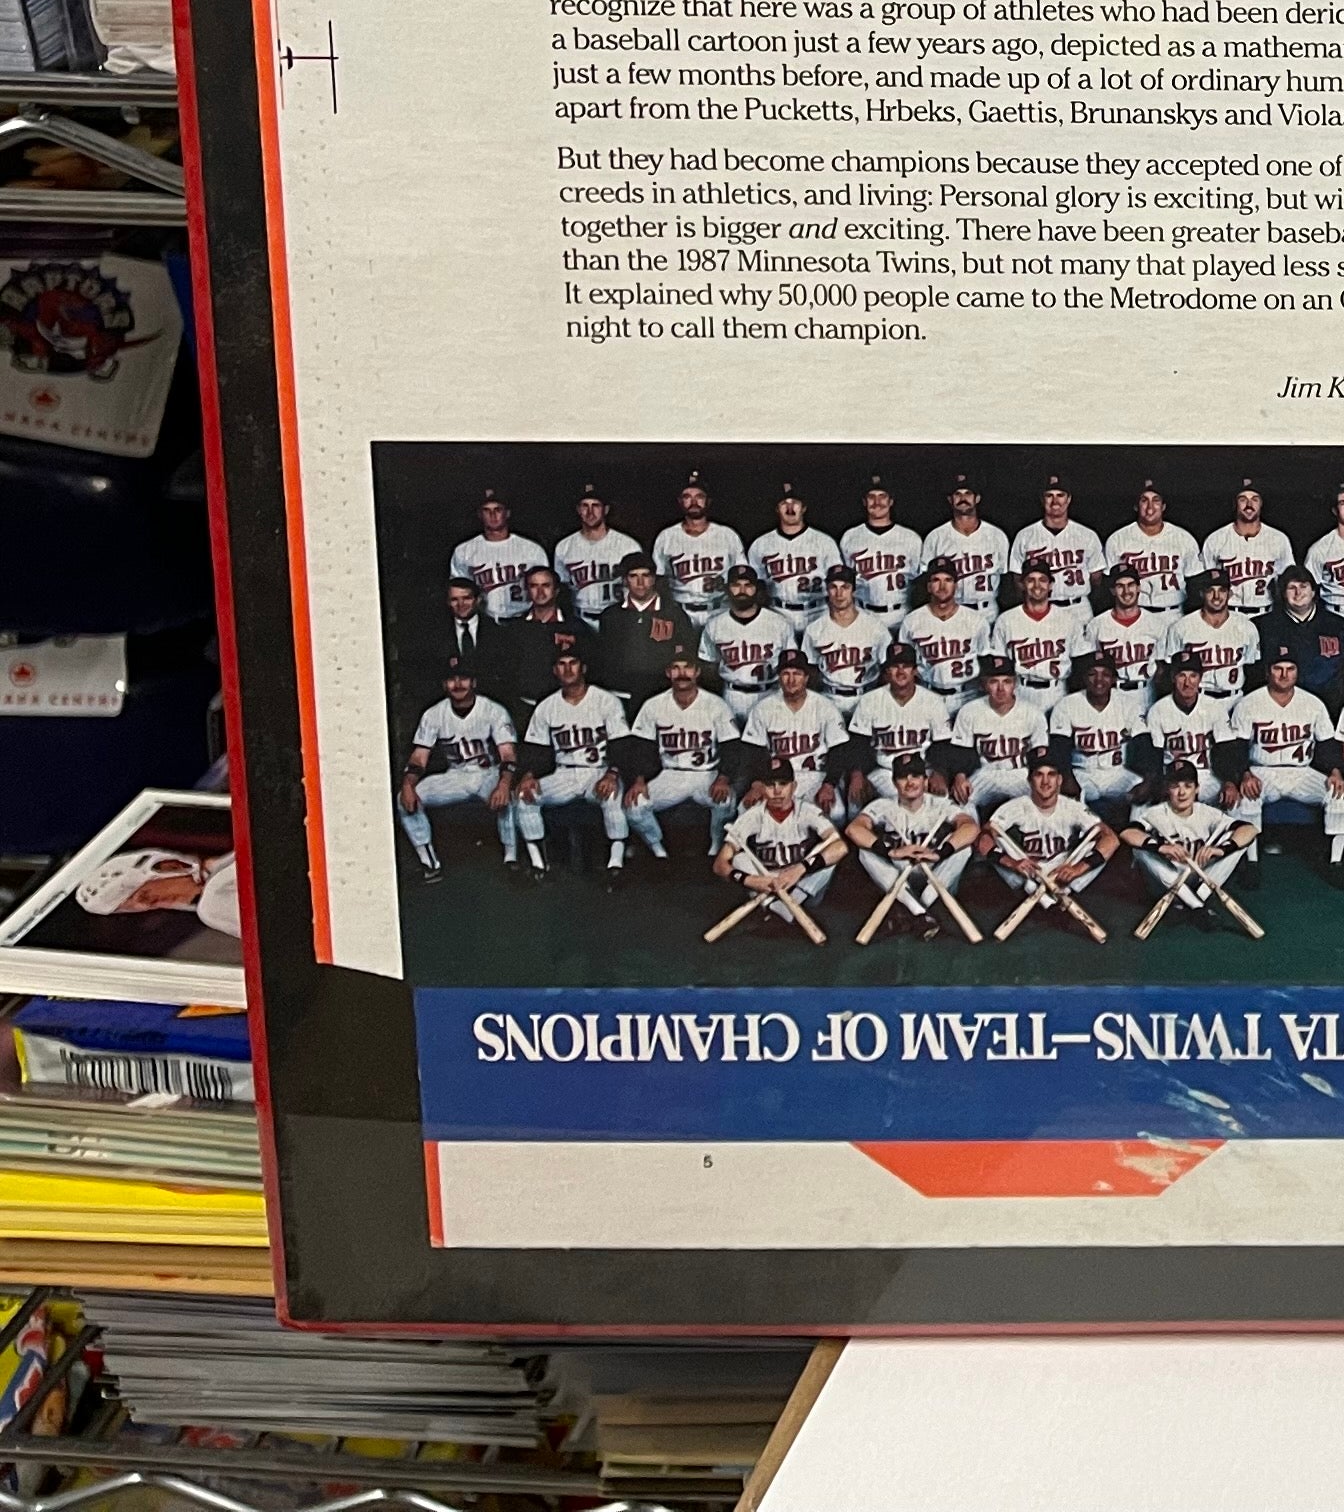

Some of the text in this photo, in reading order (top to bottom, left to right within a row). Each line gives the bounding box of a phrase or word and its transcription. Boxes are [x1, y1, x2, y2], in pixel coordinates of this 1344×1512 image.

[1277, 376, 1321, 399] Jim
[475, 1012, 801, 1065] CHAMPIONS
[812, 1012, 888, 1062] OF
